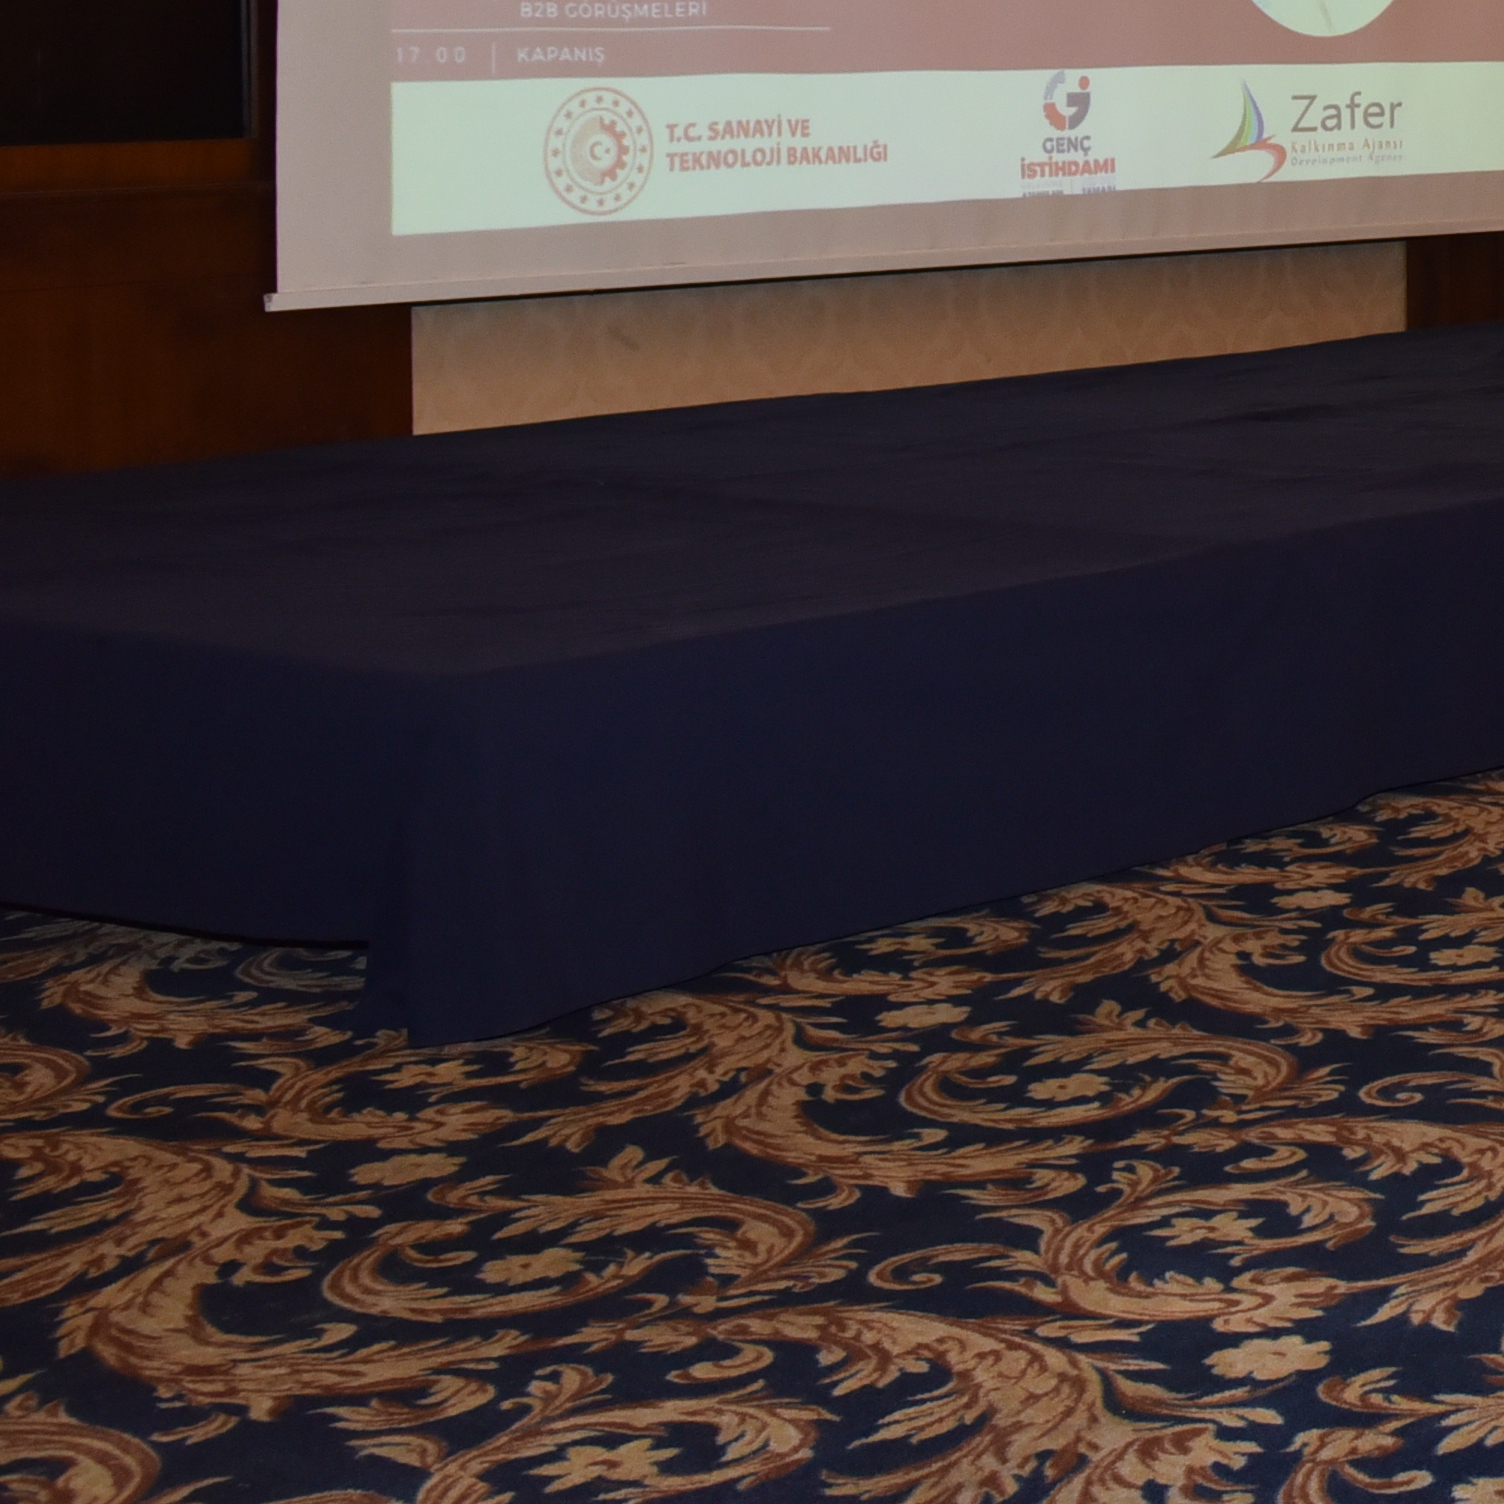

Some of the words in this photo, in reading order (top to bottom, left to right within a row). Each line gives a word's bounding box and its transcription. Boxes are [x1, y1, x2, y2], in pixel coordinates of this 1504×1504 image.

[520, 2, 559, 18] B2B
[517, 46, 606, 66] KAPANIŞ
[1291, 91, 1403, 133] Zafer
[665, 123, 702, 144] T.C.
[708, 114, 782, 141] SANAYİ
[787, 118, 811, 138] VE
[666, 142, 782, 173] TEKNOLOJİ
[786, 139, 889, 167] BAKANLIĞI
[1042, 135, 1092, 157] GENÇ
[1020, 155, 1116, 180] İSTİHDAMI
